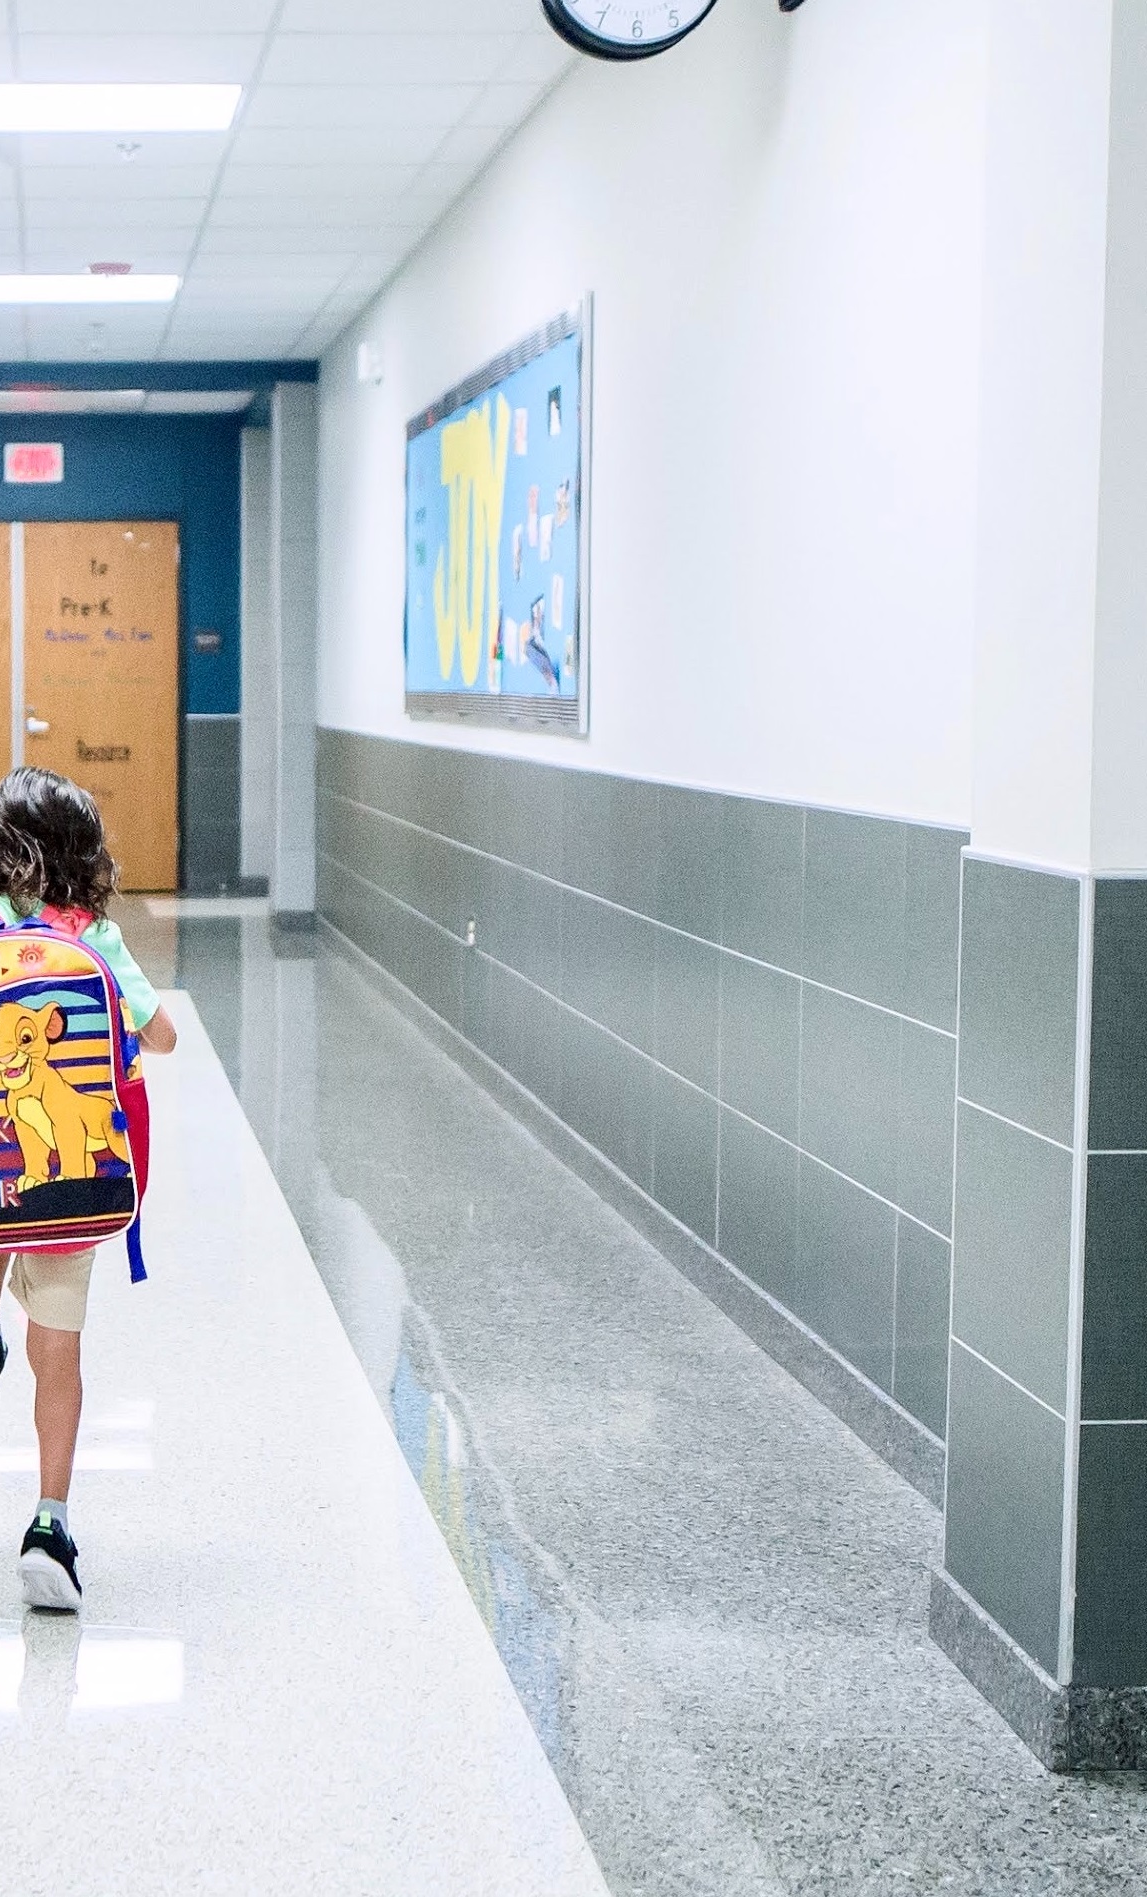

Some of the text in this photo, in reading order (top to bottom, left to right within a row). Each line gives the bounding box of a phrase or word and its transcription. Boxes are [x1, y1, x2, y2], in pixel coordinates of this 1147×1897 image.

[594, 10, 607, 28] 7
[668, 10, 679, 28] 5
[632, 20, 643, 38] 6
